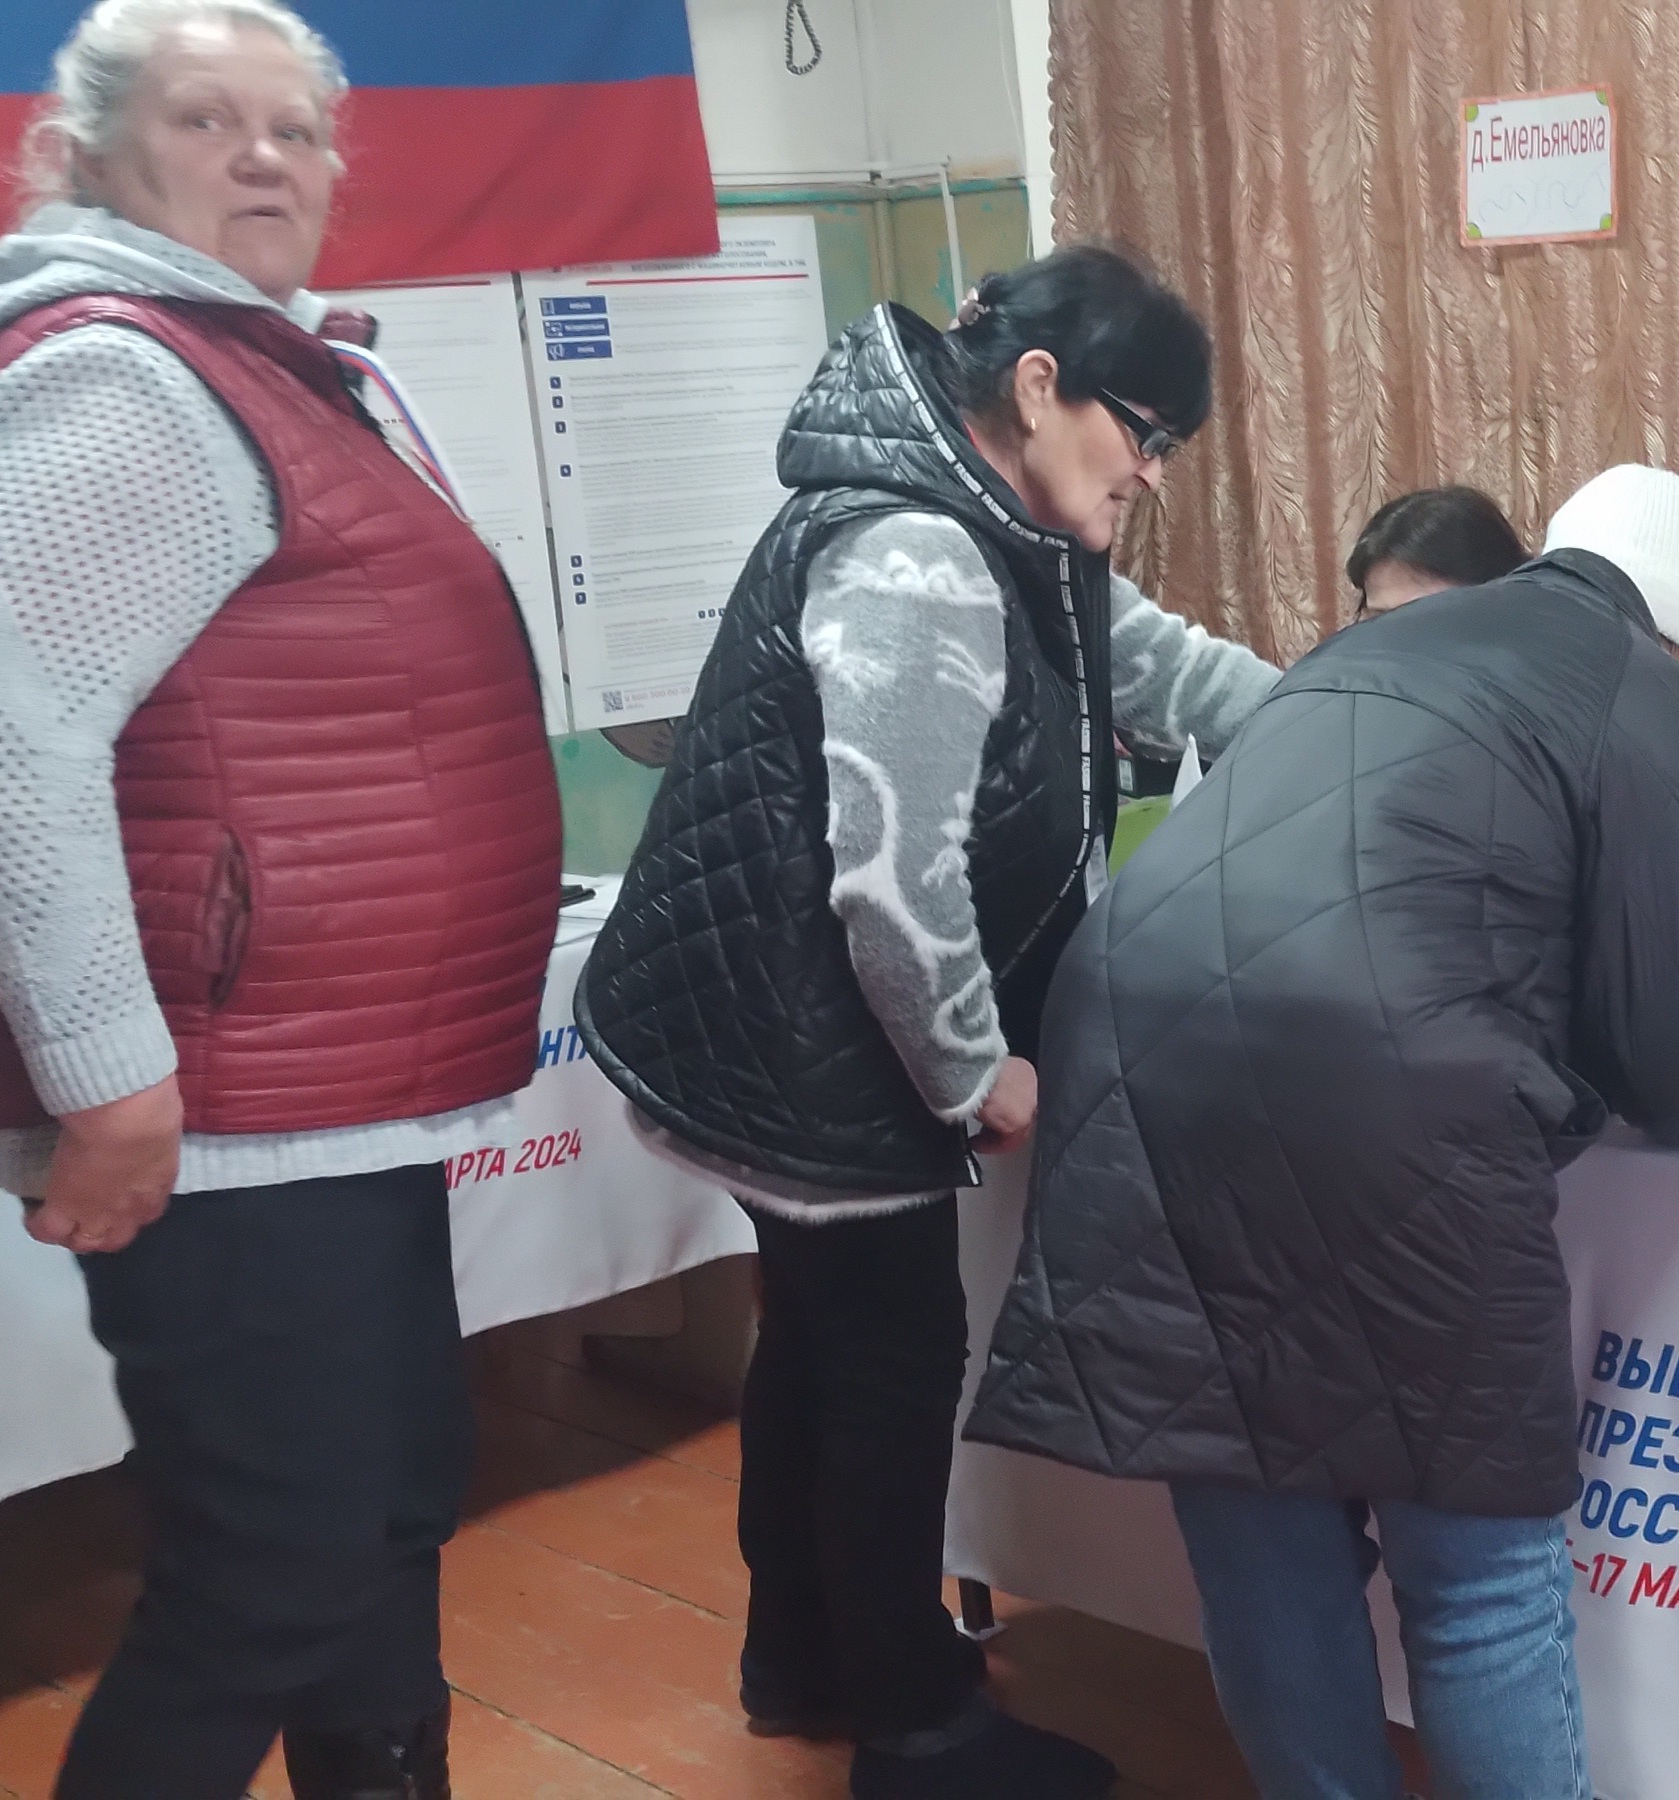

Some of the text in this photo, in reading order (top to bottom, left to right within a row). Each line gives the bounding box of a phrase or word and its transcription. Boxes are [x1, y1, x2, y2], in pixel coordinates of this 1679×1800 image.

[1471, 115, 1606, 173] д.Емельяновка
[536, 1025, 587, 1069] НТ
[443, 1128, 582, 1191] АРТА 2024
[1566, 1538, 1628, 1598] -17
